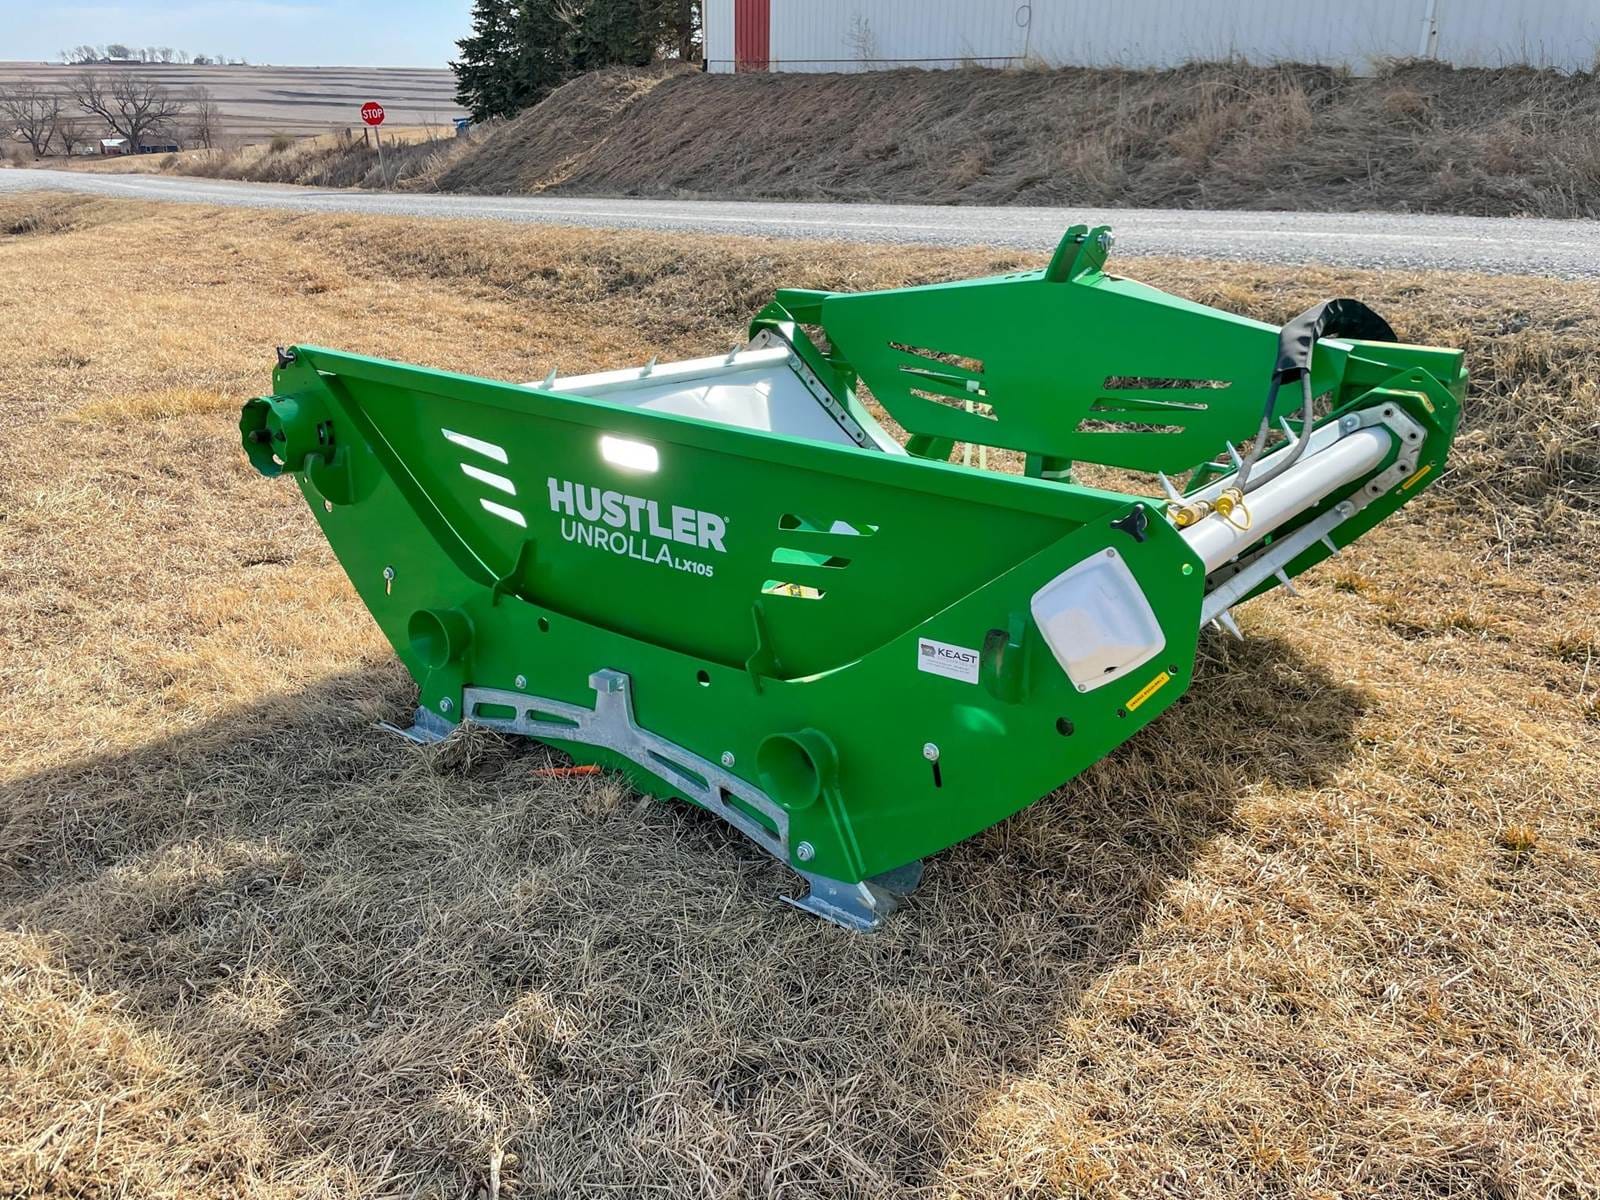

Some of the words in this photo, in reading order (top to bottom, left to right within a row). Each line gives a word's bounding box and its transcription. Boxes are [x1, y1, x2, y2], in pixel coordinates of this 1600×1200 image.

[363, 109, 383, 119] STOP
[547, 477, 727, 552] HUSTLER
[561, 518, 673, 567] UNROLLA
[675, 557, 713, 577] LX105
[938, 648, 977, 664] KEAST
